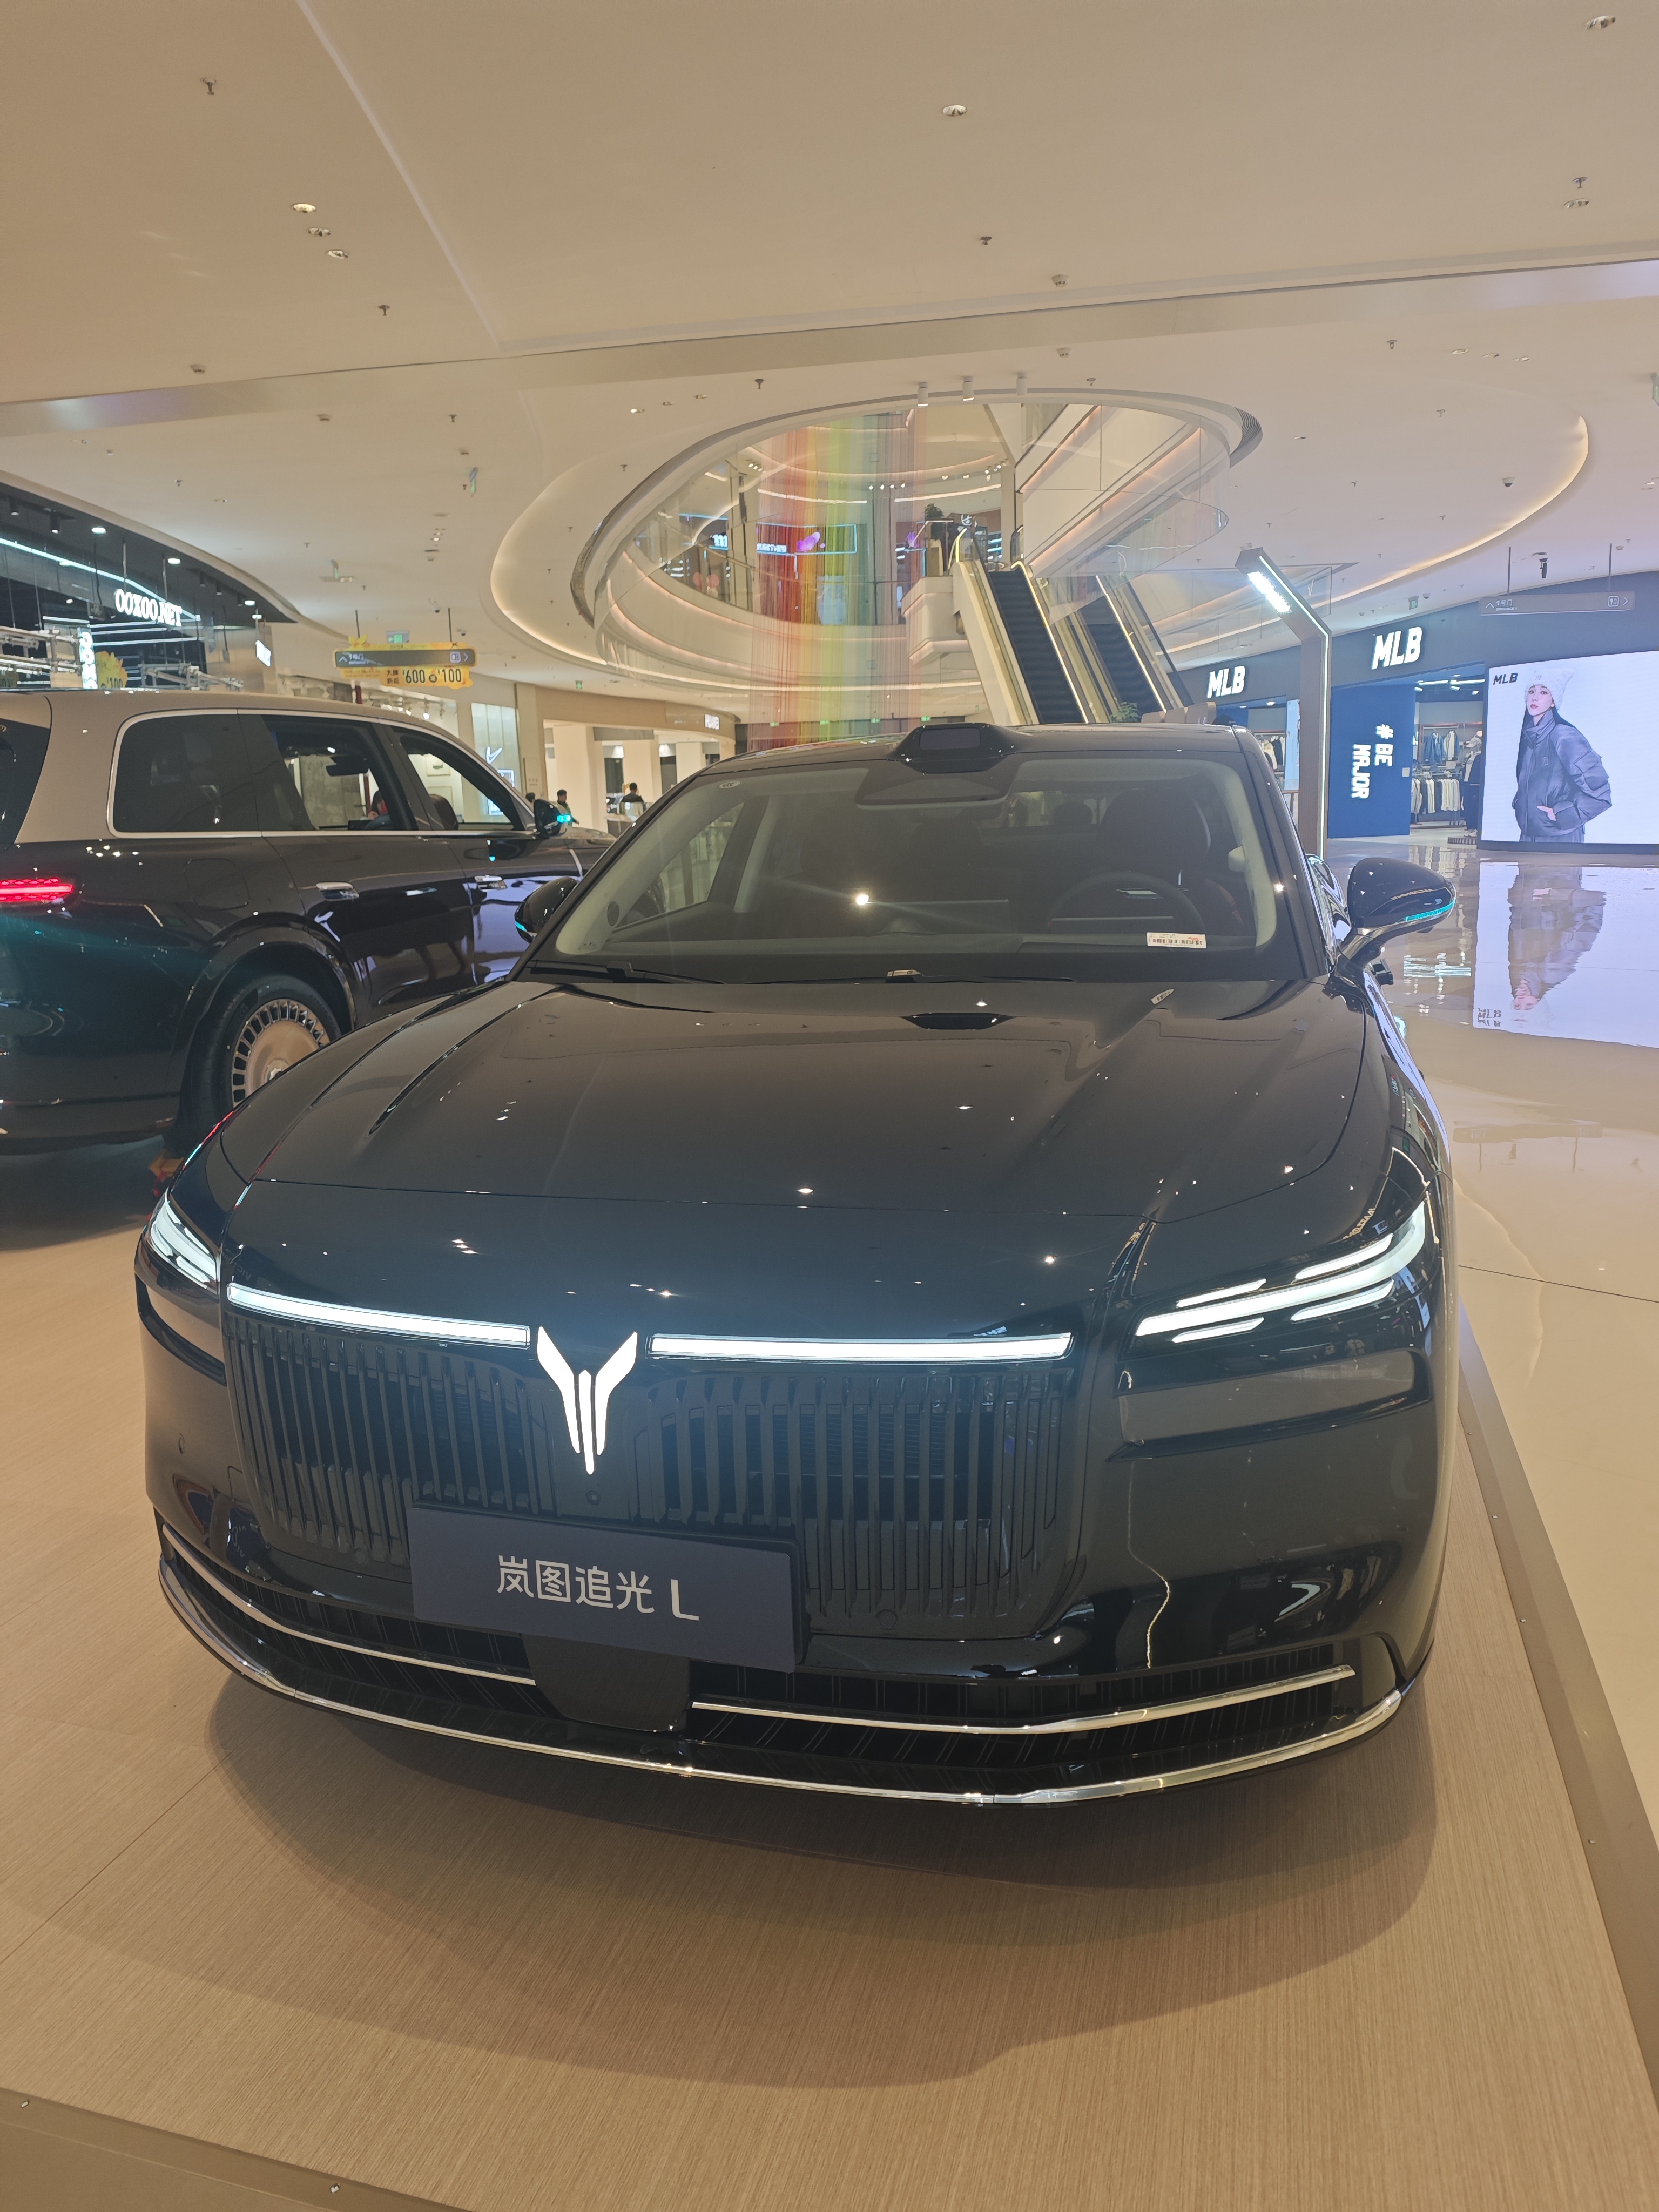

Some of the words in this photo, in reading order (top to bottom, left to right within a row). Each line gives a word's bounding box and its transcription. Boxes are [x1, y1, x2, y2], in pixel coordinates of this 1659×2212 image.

[1372, 626, 1422, 670] MLB
[1206, 665, 1246, 698] MLB
[1493, 673, 1518, 685] MLB
[1351, 744, 1371, 798] MAJOR
[497, 1555, 655, 1613] 岚图追光
[671, 1579, 699, 1621] L
